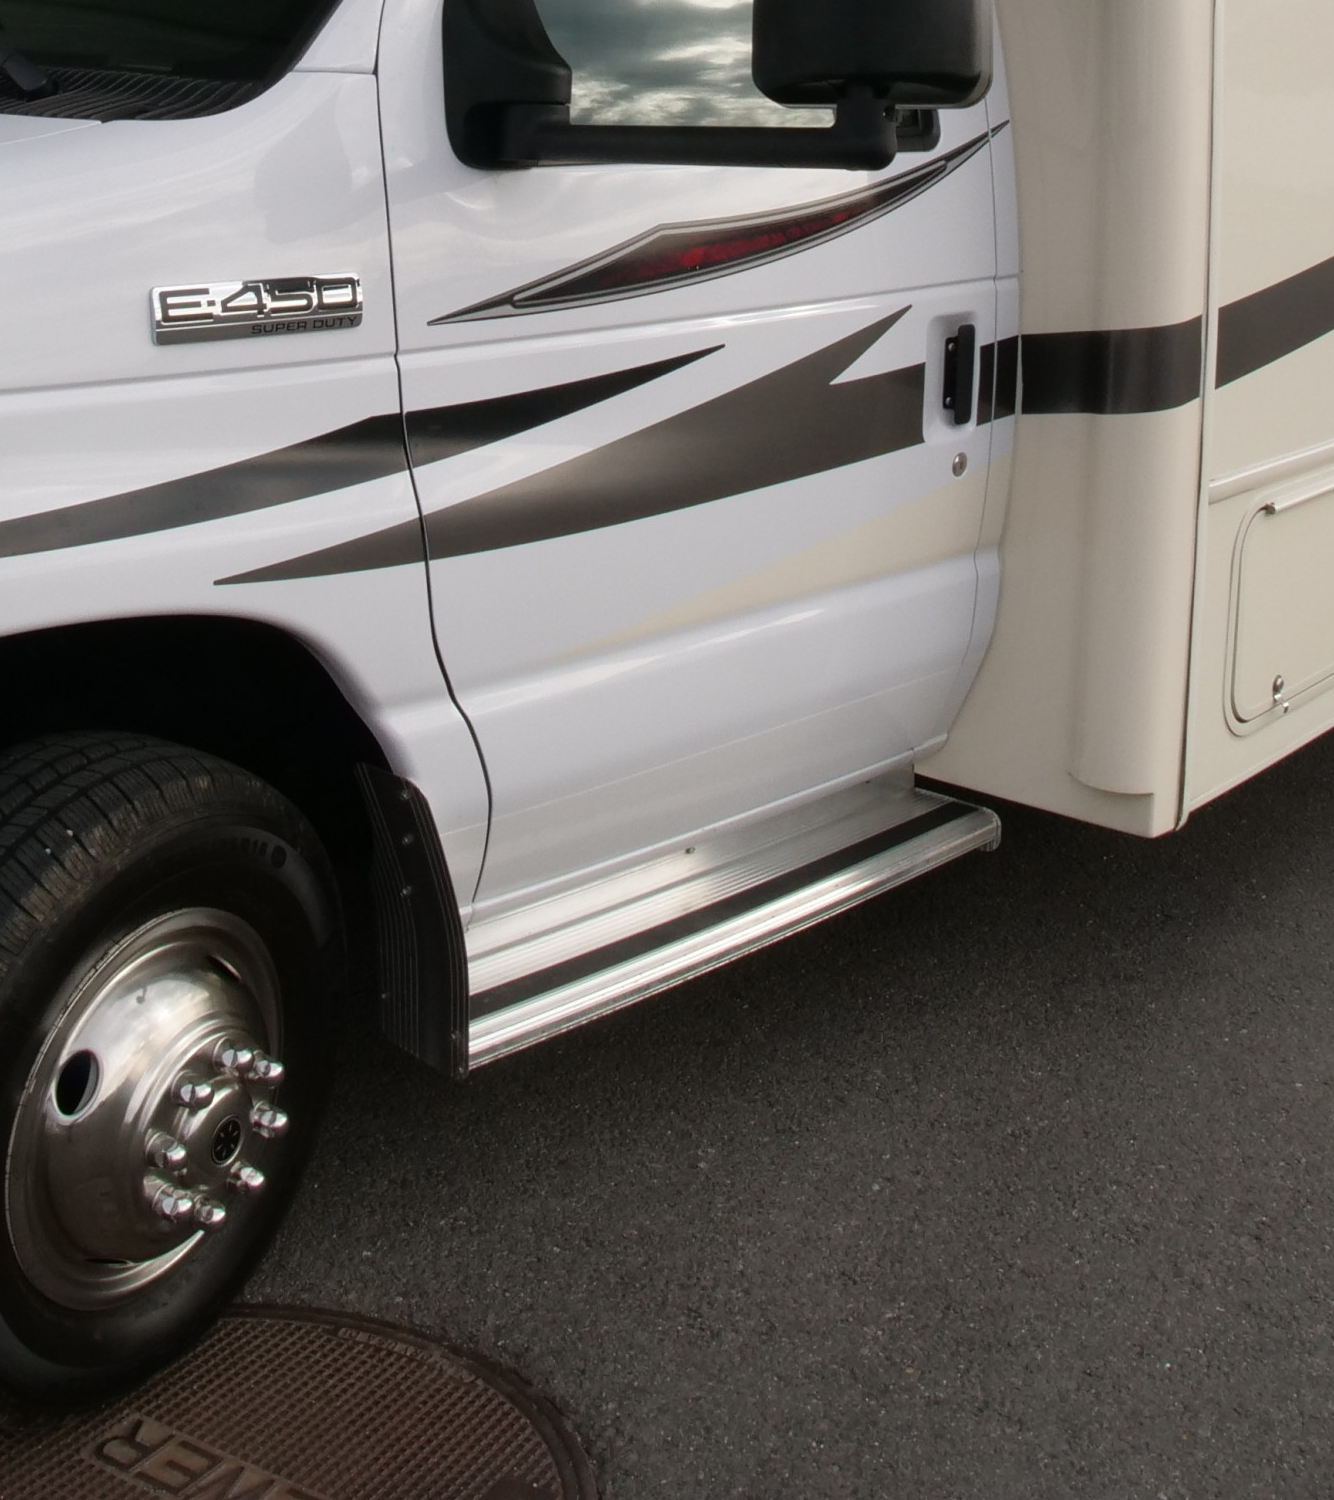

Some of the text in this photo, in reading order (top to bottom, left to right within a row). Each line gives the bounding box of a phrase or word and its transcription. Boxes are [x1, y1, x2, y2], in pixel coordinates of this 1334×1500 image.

[158, 276, 358, 324] E-450
[251, 315, 358, 336] SUPER DUTY
